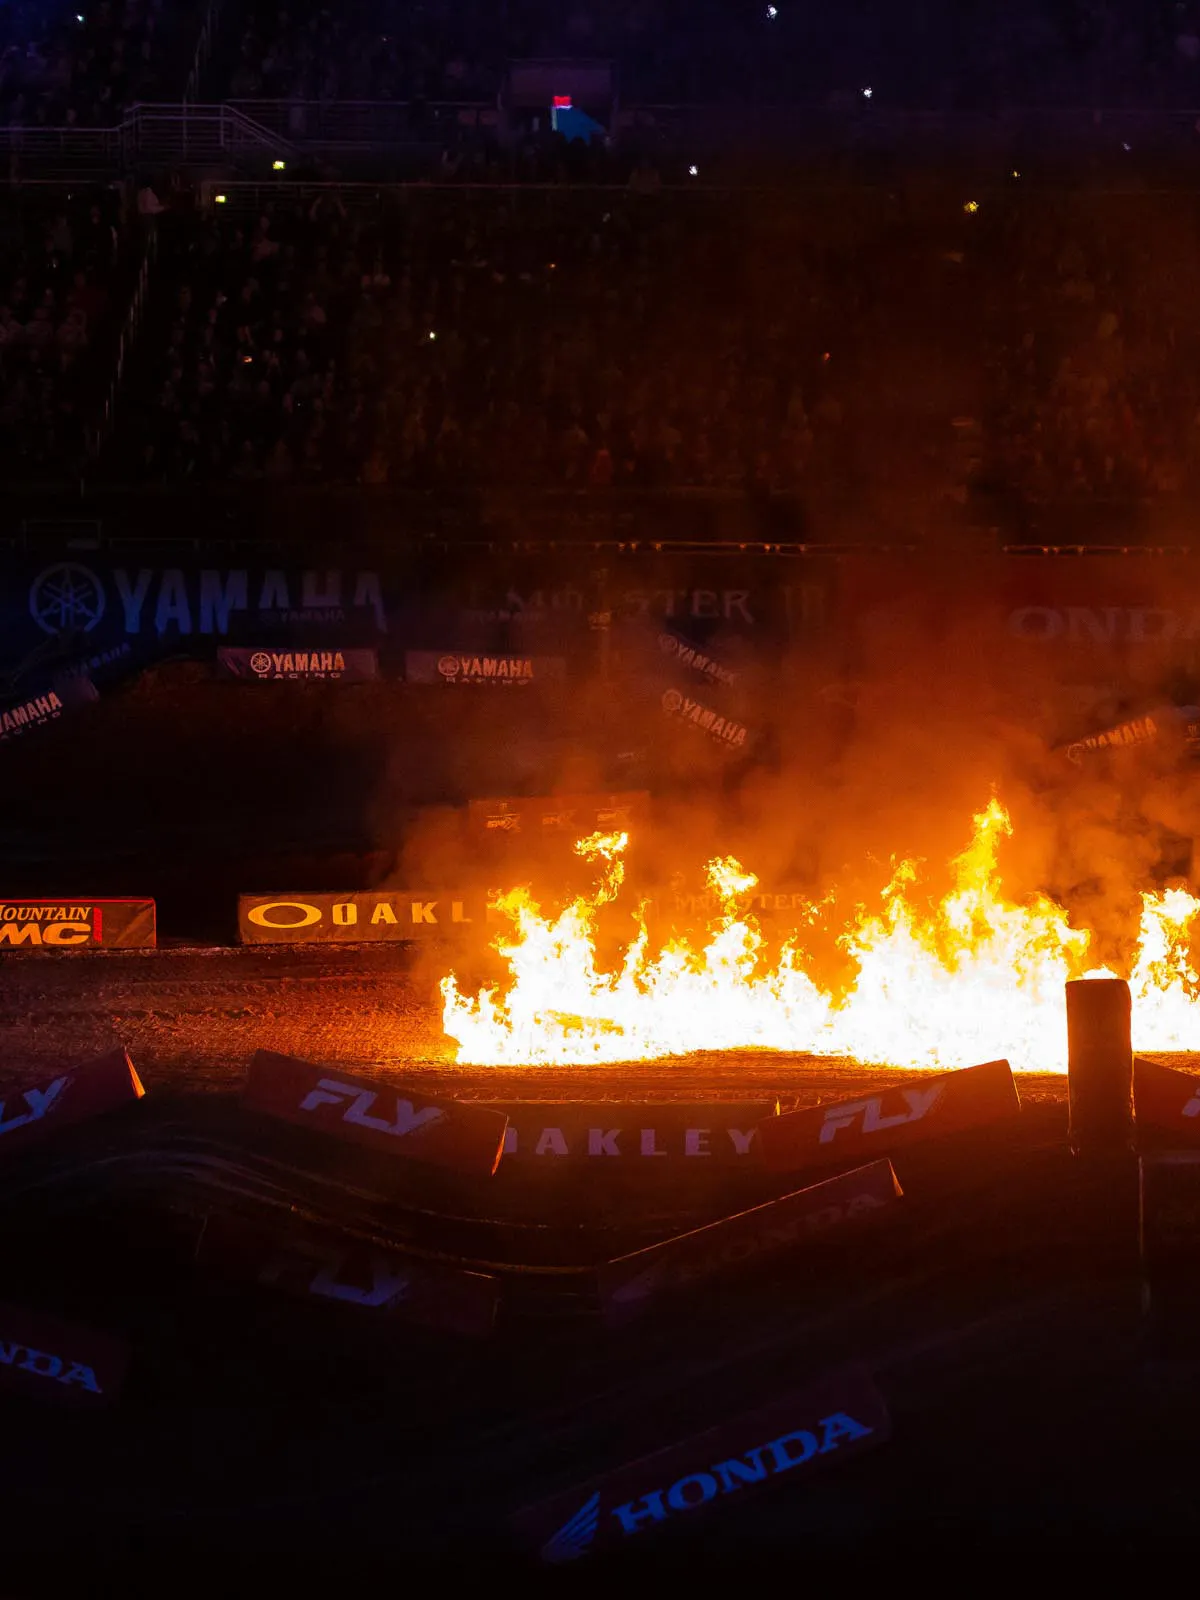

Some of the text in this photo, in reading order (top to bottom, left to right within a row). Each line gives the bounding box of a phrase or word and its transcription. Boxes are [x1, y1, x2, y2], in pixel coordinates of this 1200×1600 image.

[272, 651, 345, 672] YAMAHA
[460, 656, 535, 678] YAMAHA
[0, 691, 64, 733] AMAHA
[682, 696, 749, 747] YAMAHA
[300, 1078, 448, 1136] FLY
[818, 1081, 947, 1143] FLY
[610, 1410, 877, 1536] HONDA
